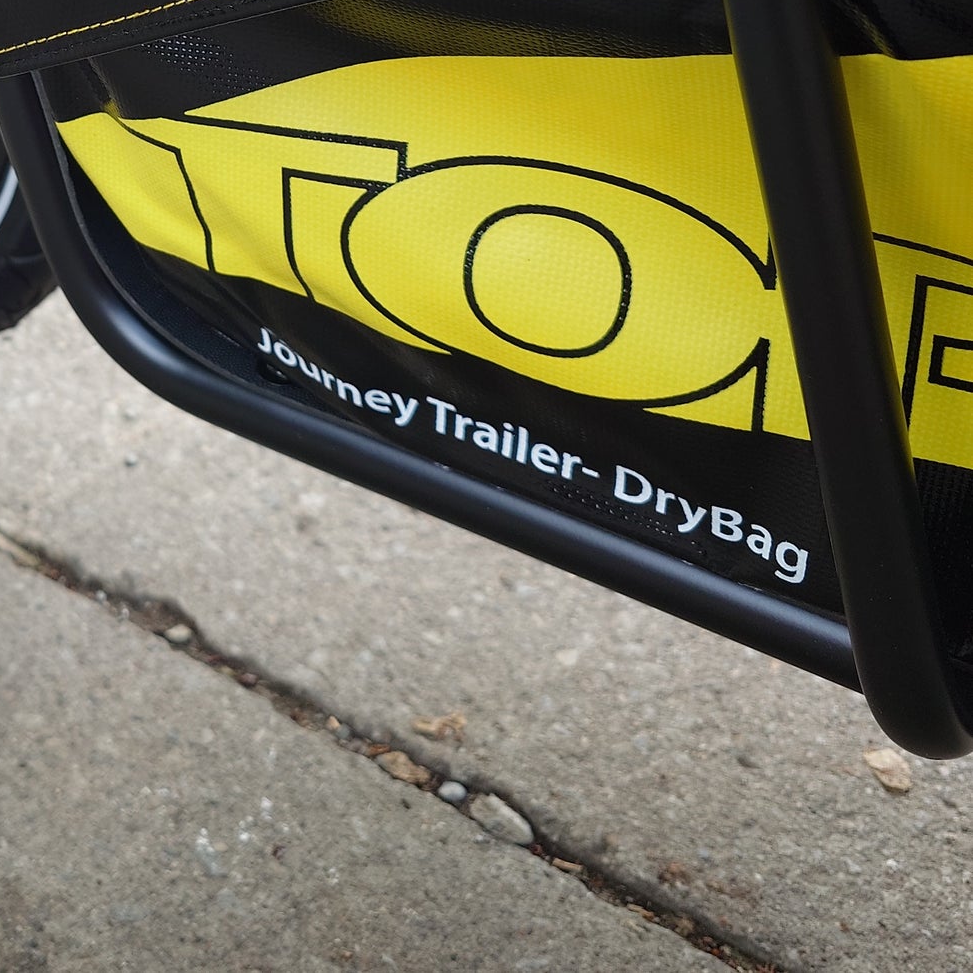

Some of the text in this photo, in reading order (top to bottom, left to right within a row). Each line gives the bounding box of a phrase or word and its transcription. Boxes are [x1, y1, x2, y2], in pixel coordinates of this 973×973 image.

[256, 326, 810, 585] Journey Trailer- DryBag
